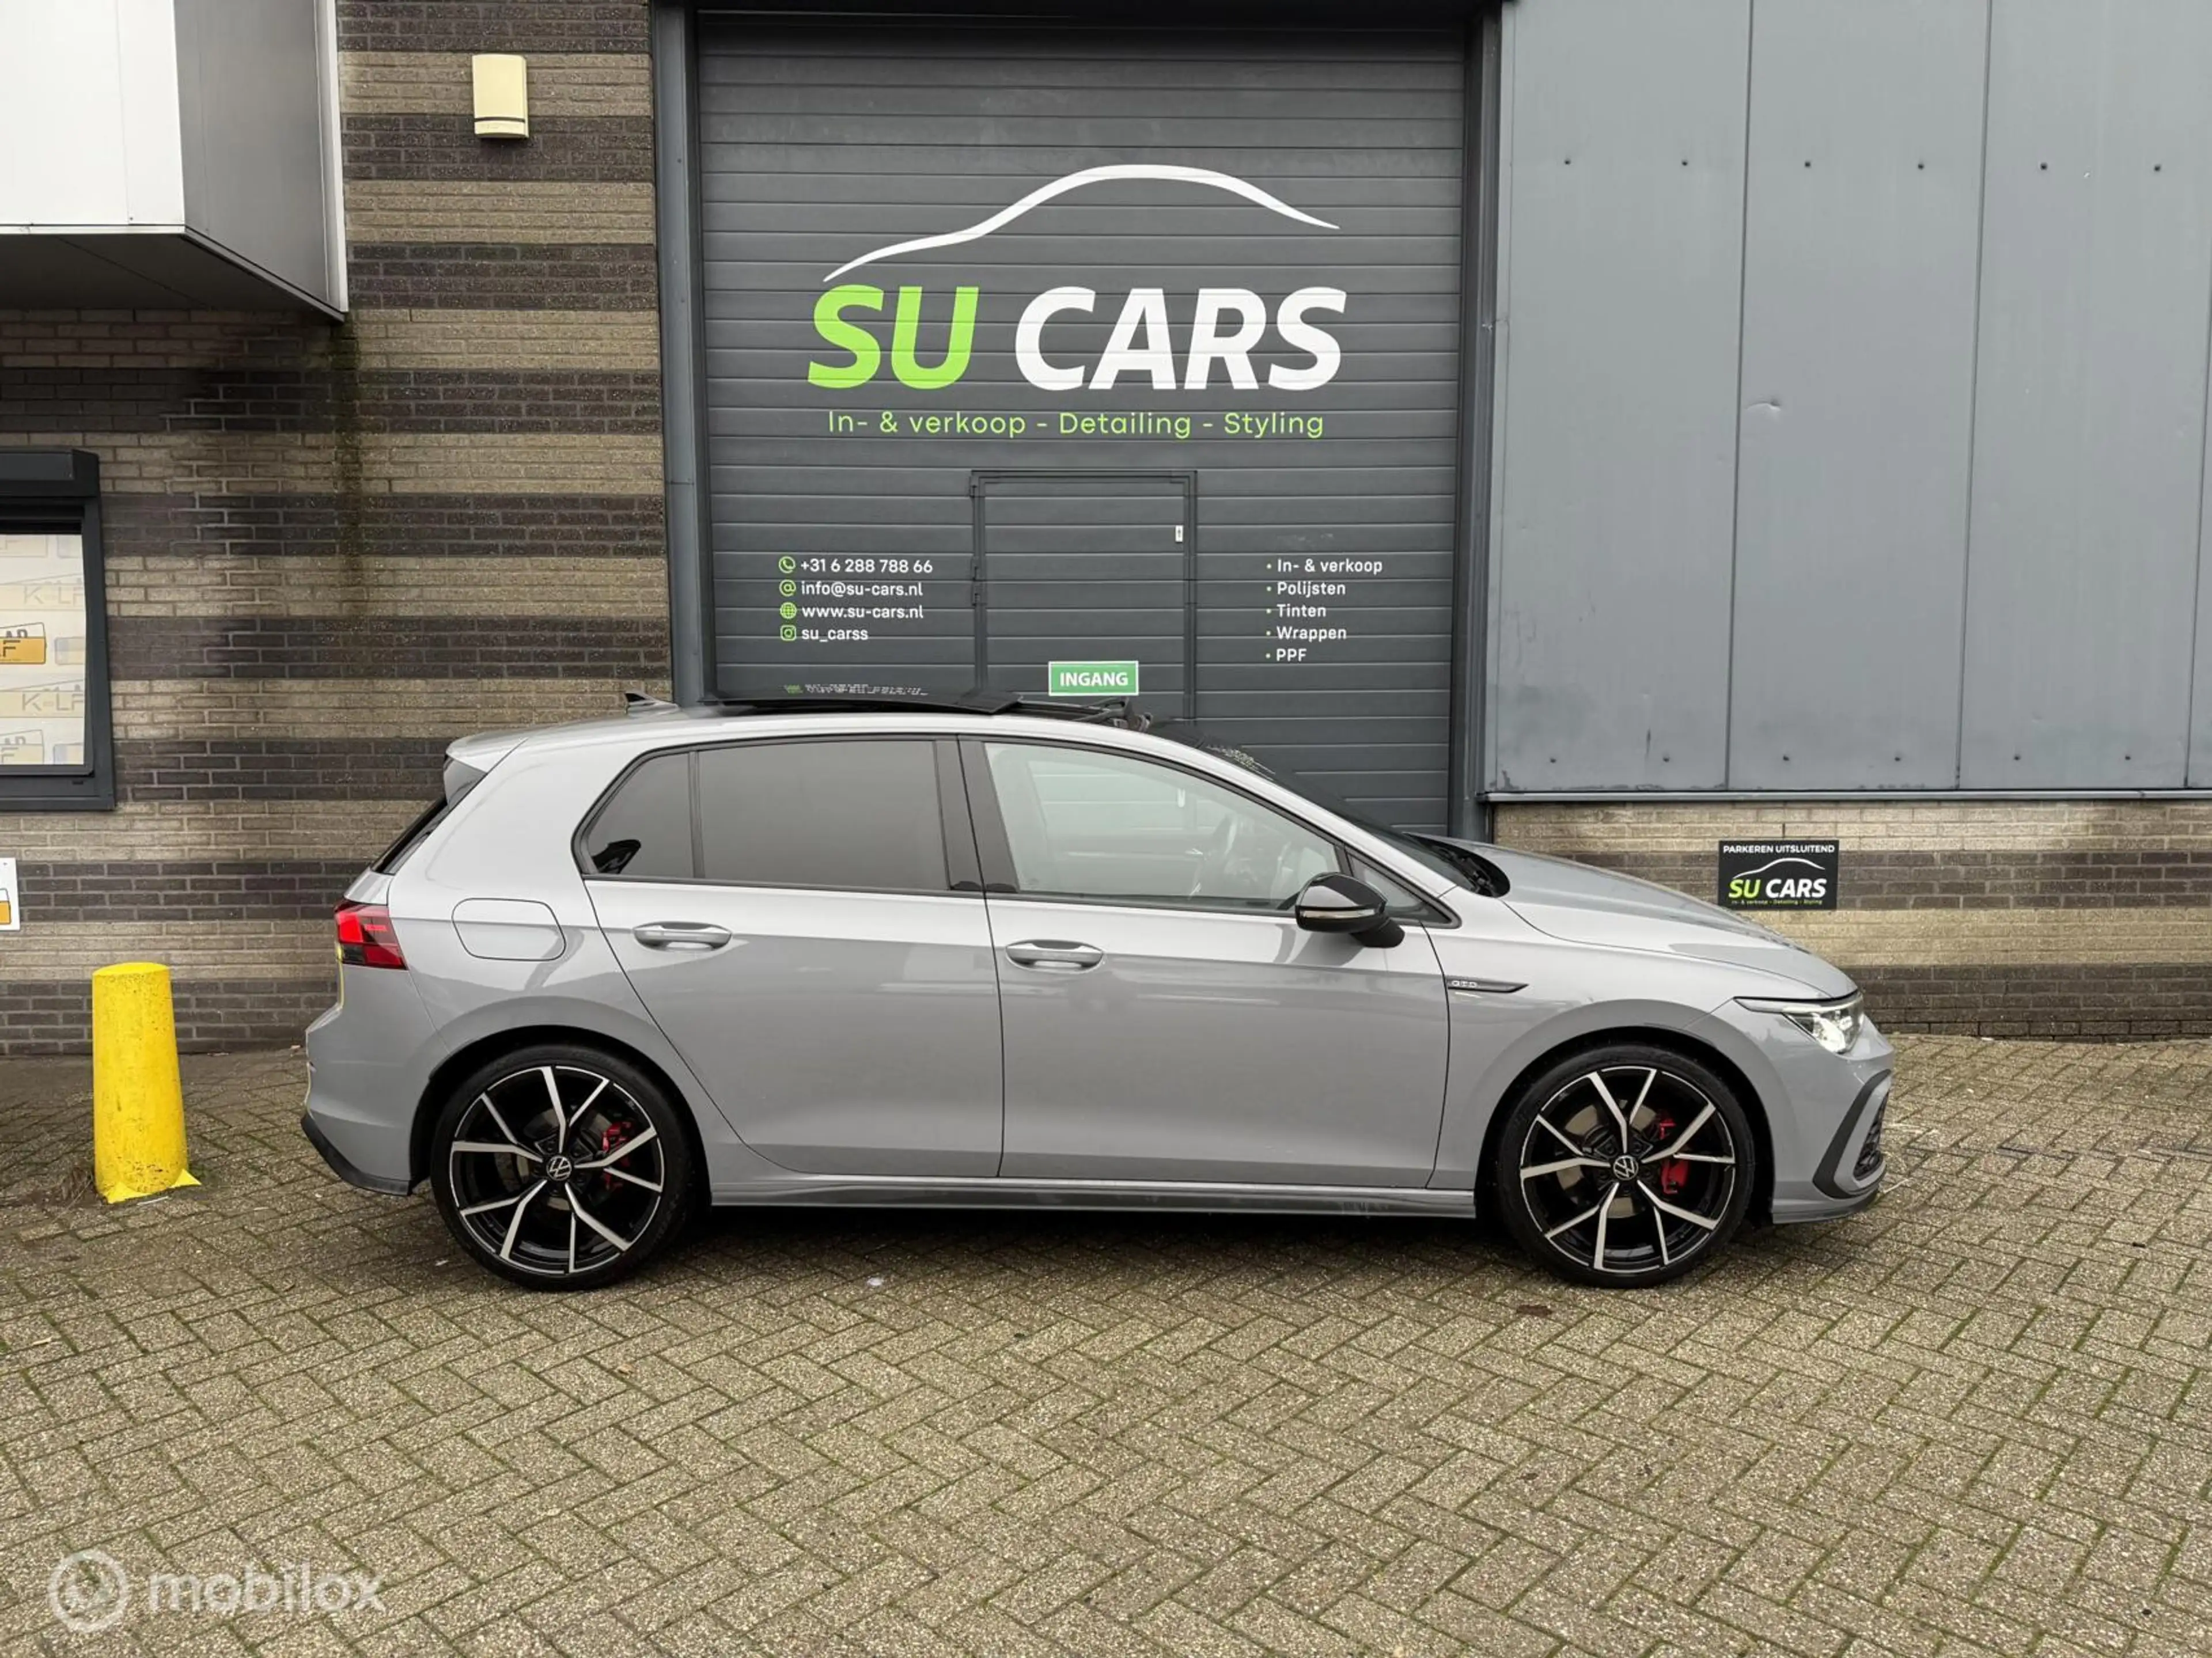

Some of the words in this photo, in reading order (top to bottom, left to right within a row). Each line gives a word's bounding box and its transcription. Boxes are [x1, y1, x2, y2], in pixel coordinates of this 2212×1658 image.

[808, 283, 979, 390] SU
[1016, 286, 1347, 391] CARS
[828, 411, 868, 433] In-
[880, 411, 899, 434] &
[910, 411, 1027, 438] verkoop
[1059, 412, 1192, 439] Detailing
[1224, 412, 1325, 440] Styling
[801, 559, 825, 572] +31
[831, 559, 840, 572] 6
[844, 559, 875, 572] 288
[879, 560, 909, 573] 788
[913, 560, 933, 574] 66
[1278, 559, 1300, 572] In-
[1305, 559, 1316, 572] &
[1320, 559, 1383, 575] verkoop
[801, 581, 923, 597] info@su-cars.nl
[1277, 582, 1346, 598] Polijsten
[802, 605, 923, 619] www.su-cars.nl
[1277, 604, 1327, 617] Tinten
[801, 628, 869, 642] su_carss
[1277, 627, 1347, 642] Wrappen
[1276, 648, 1307, 662] PPF
[1060, 672, 1128, 686] INGANG
[1723, 845, 1774, 853] PARKEREN
[1775, 845, 1835, 853] UITSLUITEND
[1729, 879, 1761, 898] SU
[1766, 878, 1827, 898] CARS
